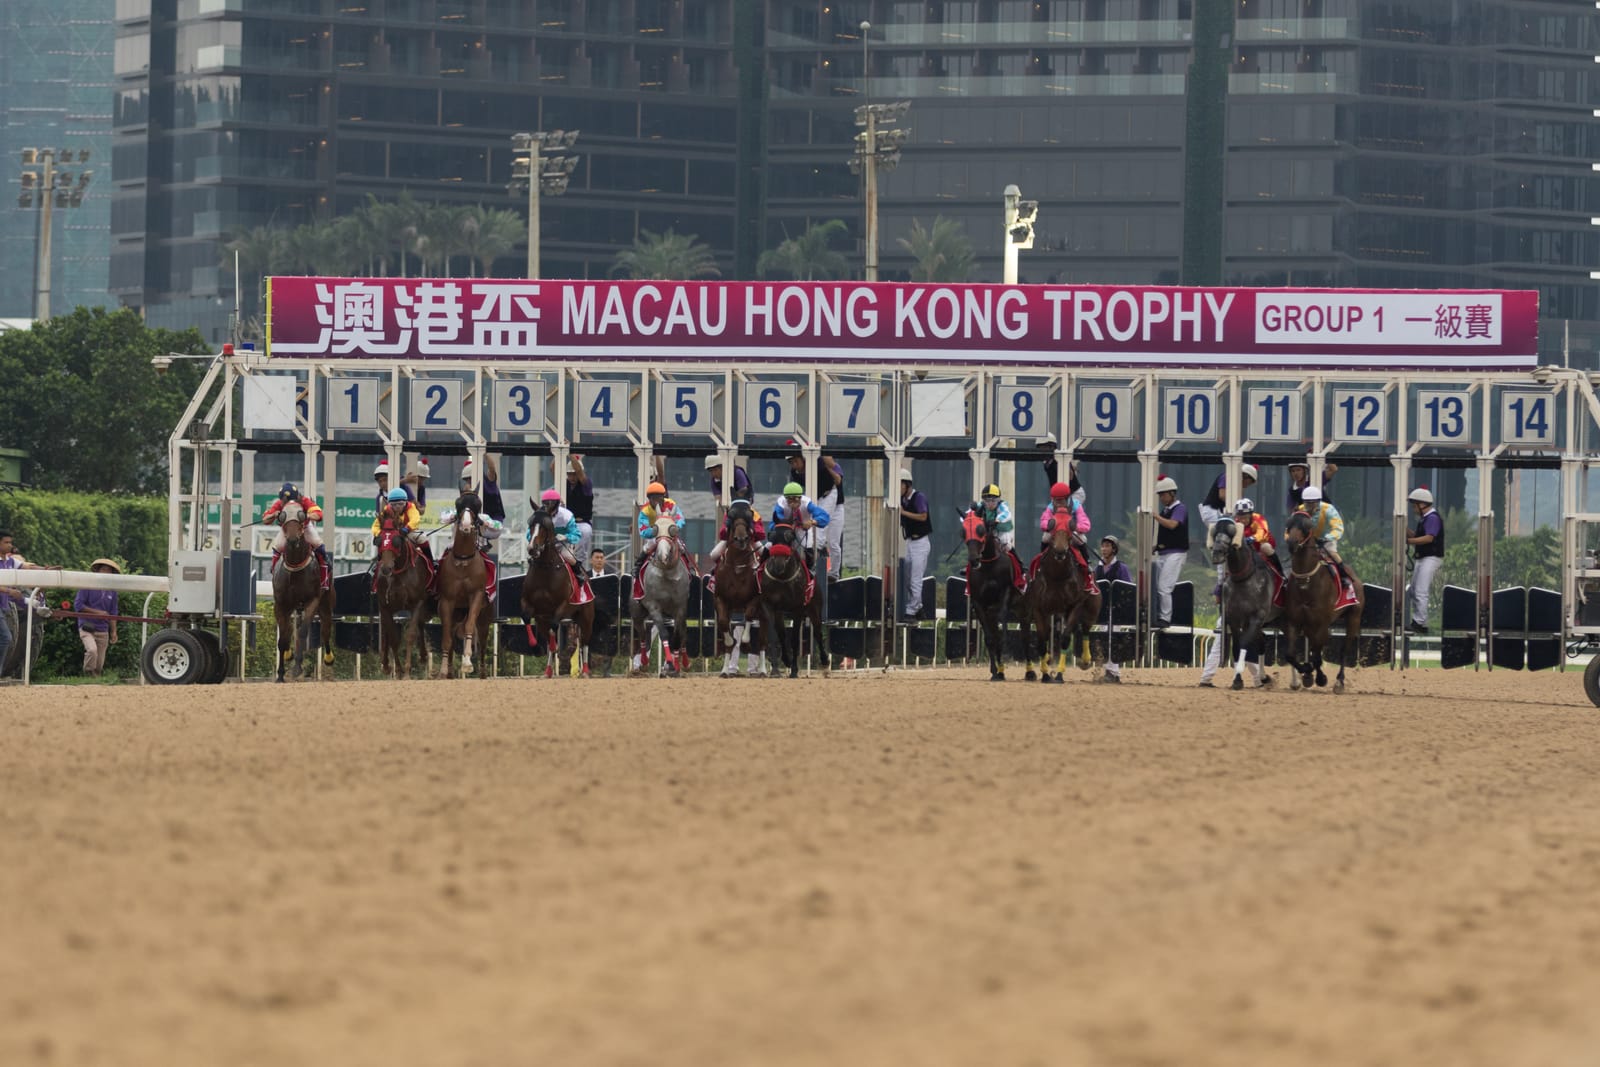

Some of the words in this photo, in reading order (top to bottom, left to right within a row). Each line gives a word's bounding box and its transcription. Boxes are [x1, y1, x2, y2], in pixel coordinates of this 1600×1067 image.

[314, 281, 541, 354] 澳港盃
[562, 284, 728, 336] MACAU
[744, 286, 879, 338] HONG
[895, 288, 1029, 340] KONG
[1043, 290, 1236, 343] TROPHY
[1261, 304, 1364, 333] GROUP
[1373, 306, 1384, 333] 1
[1404, 303, 1493, 340] 一級賽
[344, 384, 359, 424] 1
[425, 385, 448, 425] 2
[508, 386, 531, 426] 3
[590, 387, 613, 427] 4
[675, 387, 697, 428] 5
[759, 387, 781, 429] 6
[843, 388, 866, 429] 7
[1011, 391, 1033, 432] 8
[1095, 392, 1118, 433] 9
[1170, 394, 1211, 434] 10
[1258, 394, 1290, 436] 11
[1339, 396, 1380, 437] 12
[1424, 397, 1464, 438] 13
[1509, 398, 1549, 439] 14
[351, 540, 365, 553] 10
